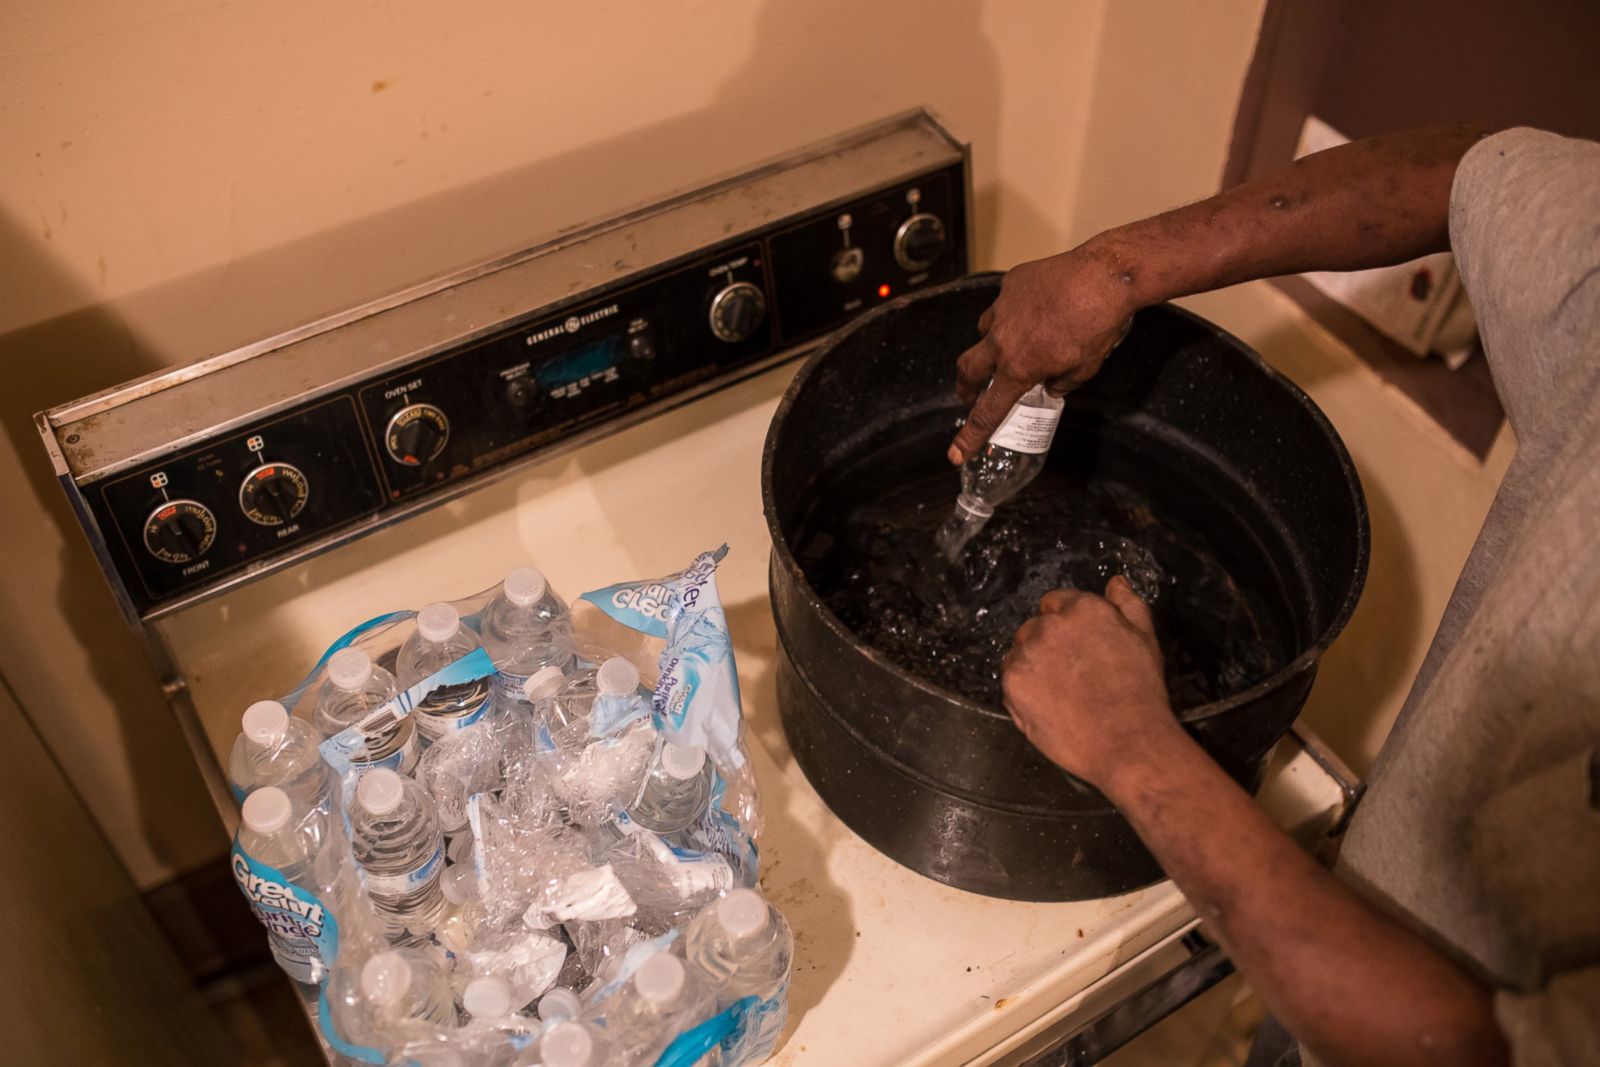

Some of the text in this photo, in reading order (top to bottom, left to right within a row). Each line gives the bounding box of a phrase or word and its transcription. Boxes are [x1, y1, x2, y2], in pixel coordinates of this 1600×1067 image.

[526, 324, 565, 346] GENERAL
[580, 303, 619, 326] ELECTRIC
[384, 379, 423, 399] OVEN SET
[276, 524, 299, 538] REAR
[182, 559, 210, 576] FRONT
